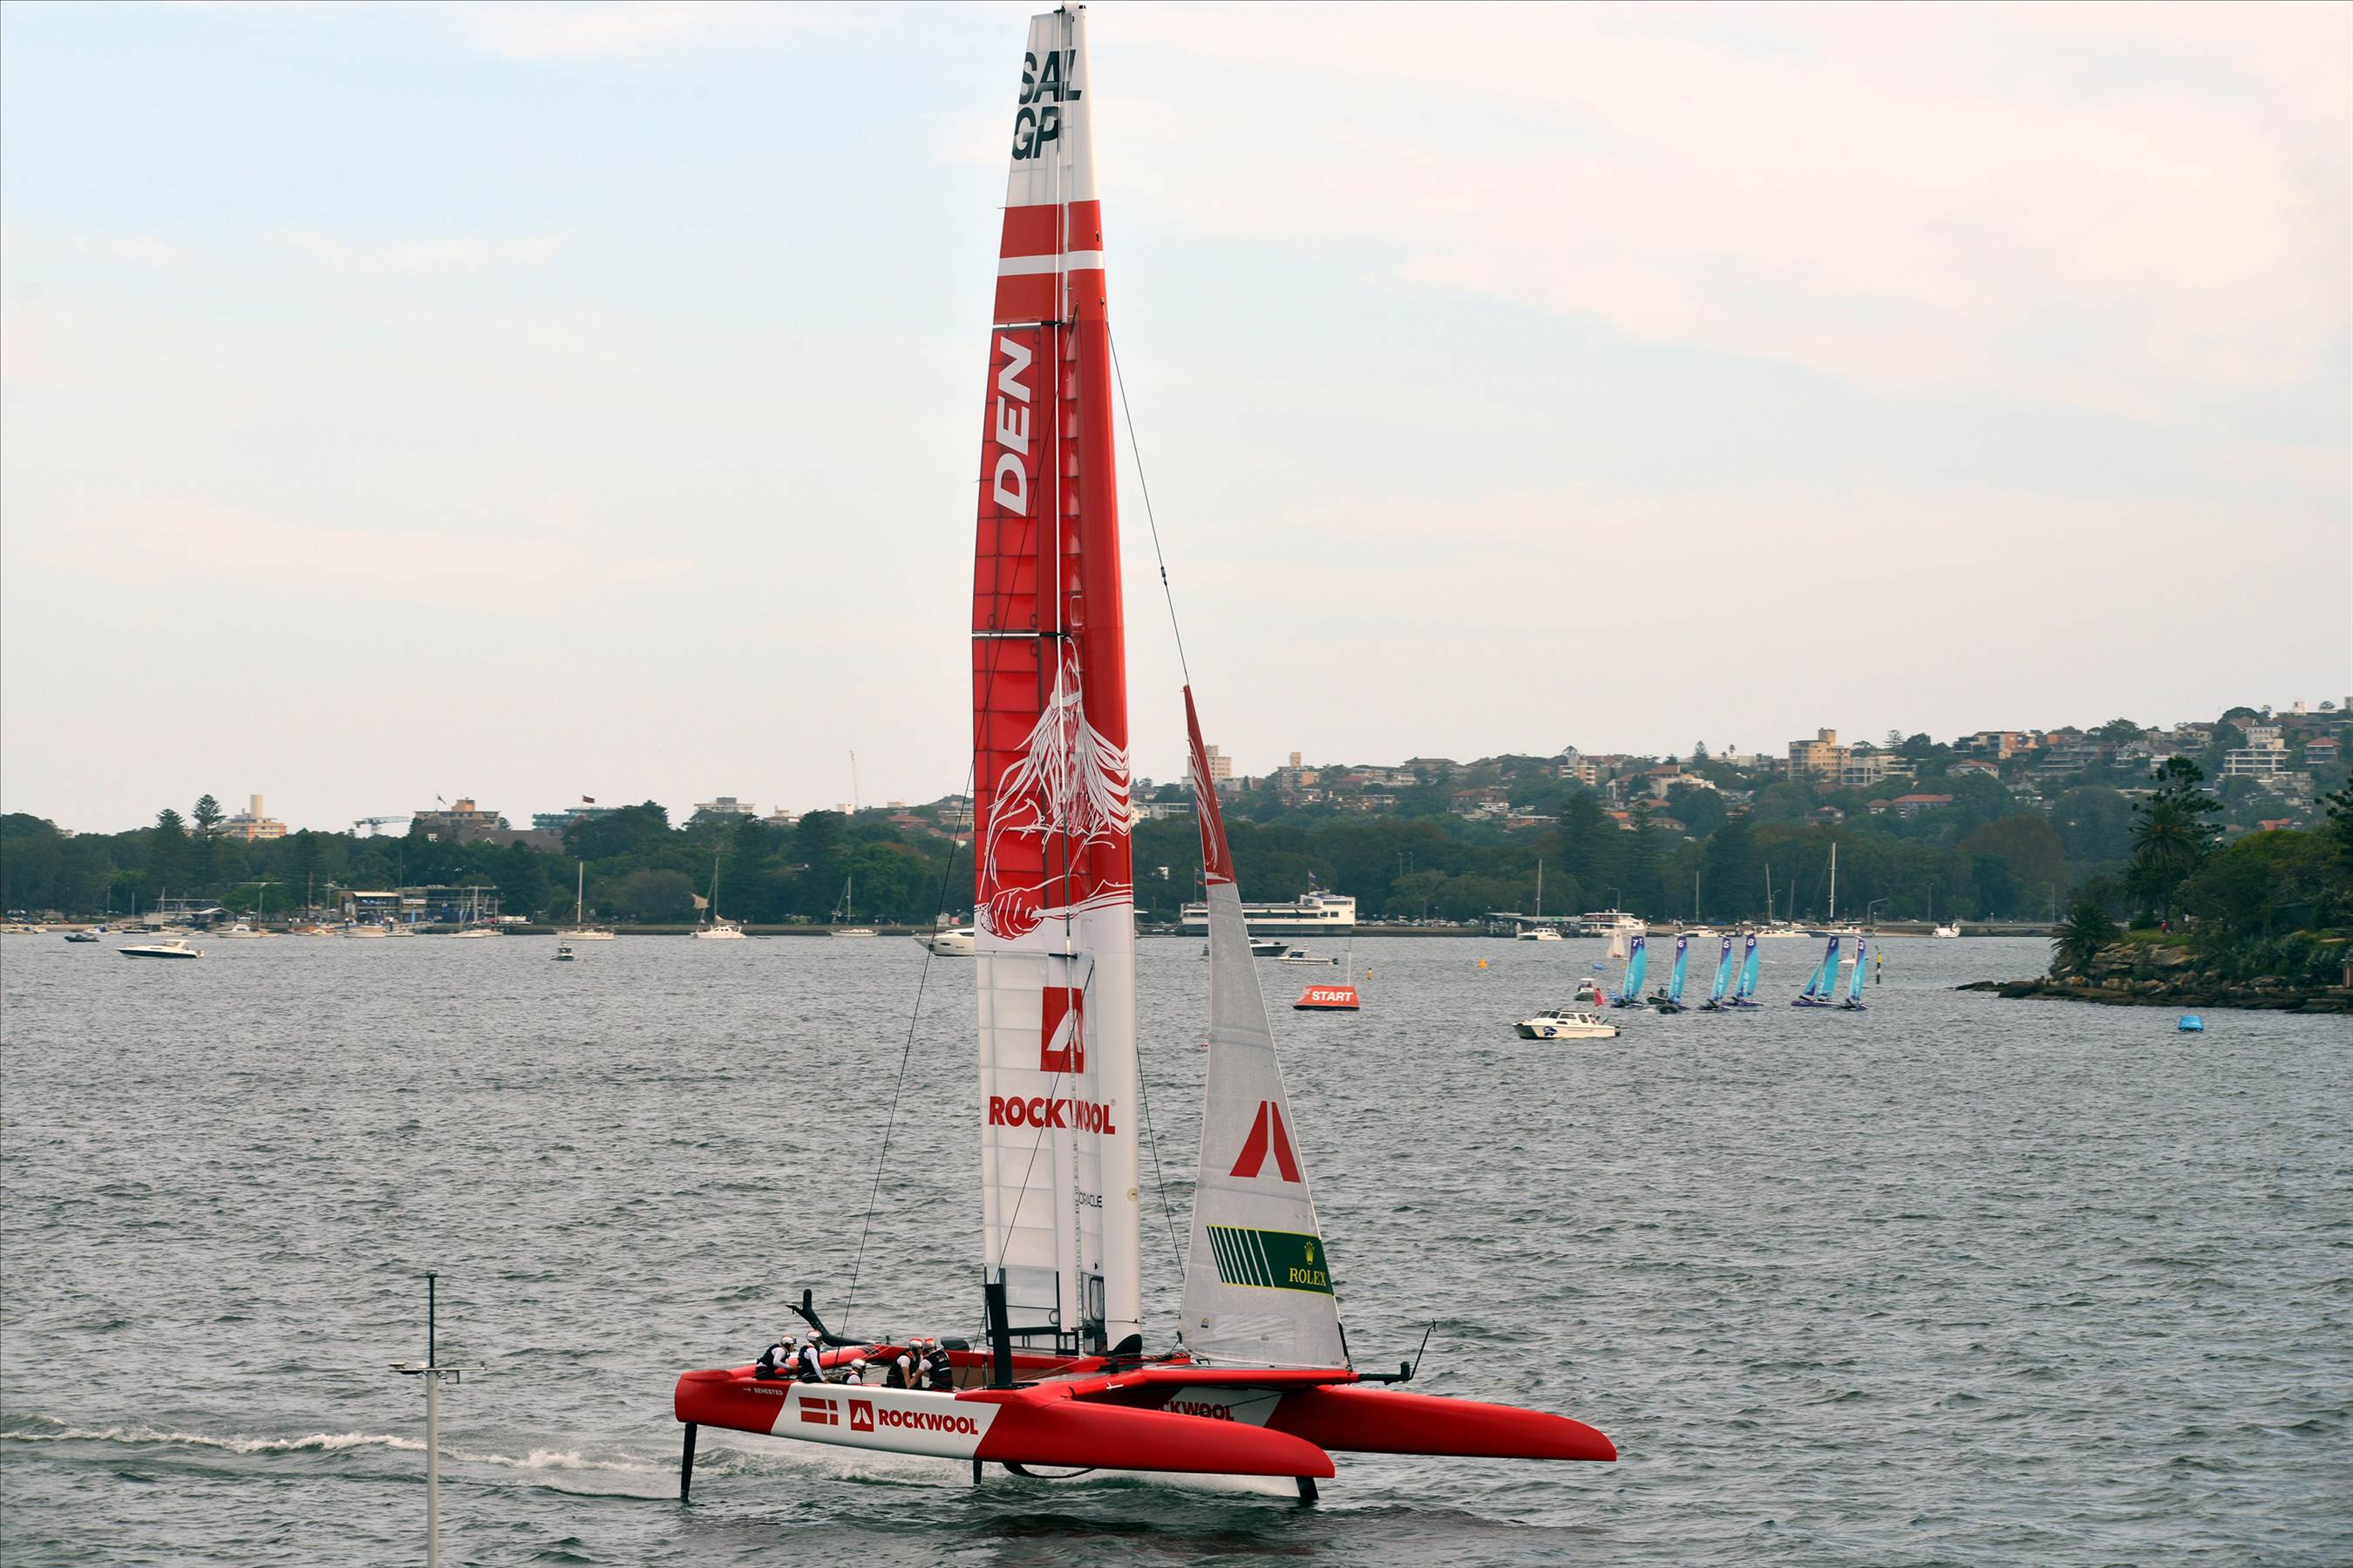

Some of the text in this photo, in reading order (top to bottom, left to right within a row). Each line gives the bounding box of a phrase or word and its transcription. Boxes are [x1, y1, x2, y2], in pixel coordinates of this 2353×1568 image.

[1012, 106, 1061, 160] GP
[994, 336, 1031, 517] DEN
[1312, 991, 1353, 1001] START
[989, 1096, 1116, 1135] ROCKWOOL
[1289, 1267, 1327, 1286] ROLEX
[878, 1408, 978, 1435] ROCKWOOL
